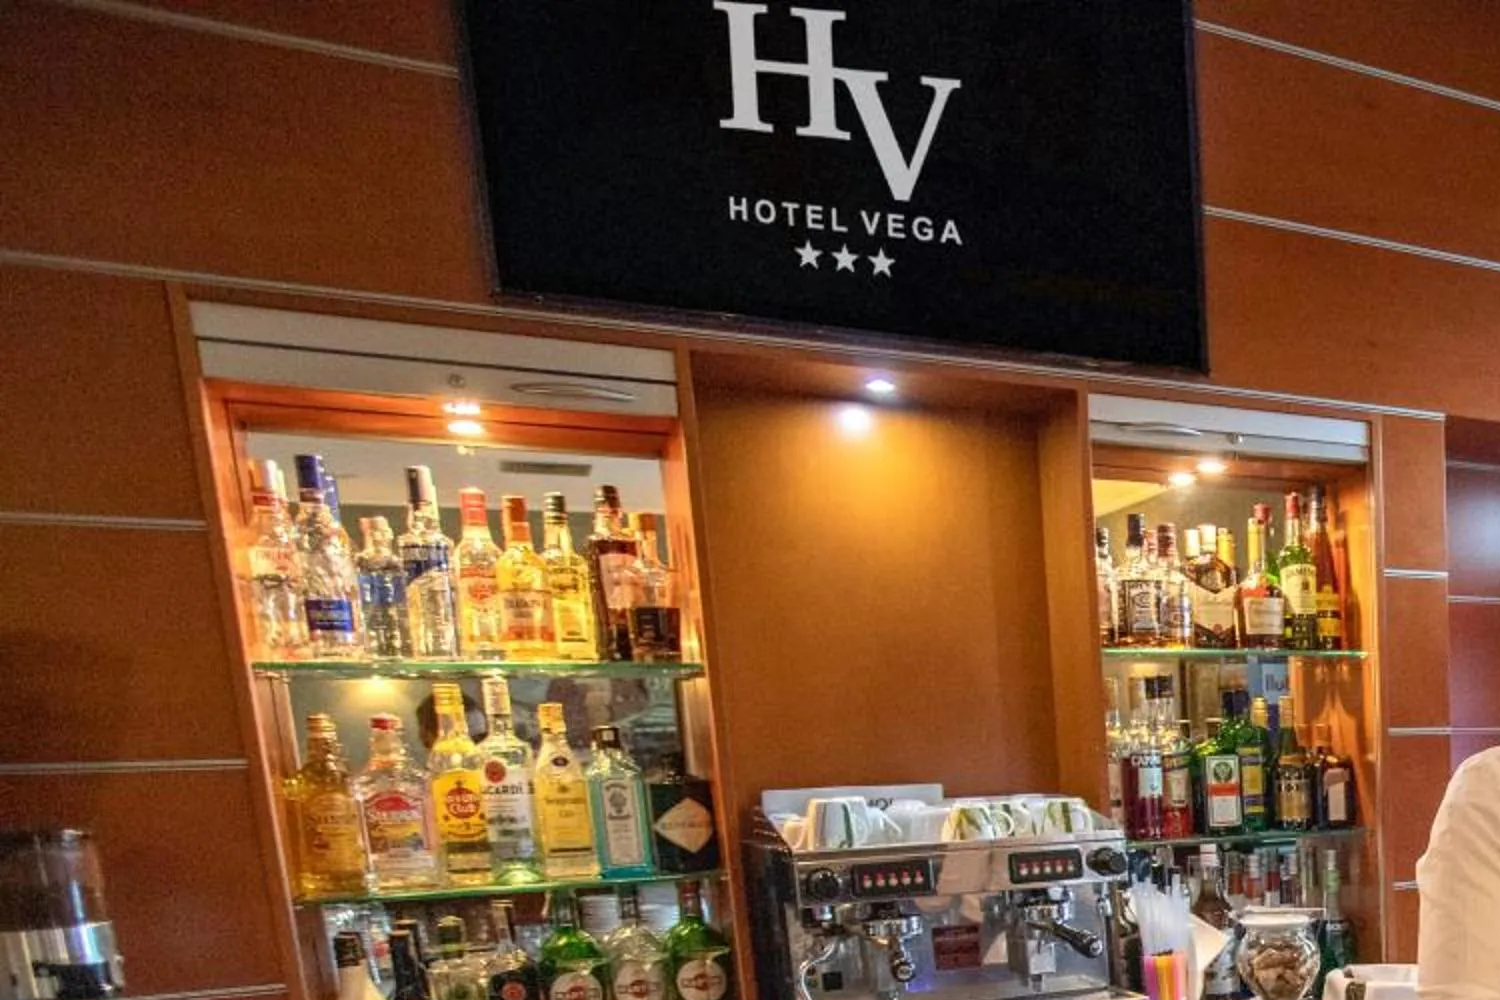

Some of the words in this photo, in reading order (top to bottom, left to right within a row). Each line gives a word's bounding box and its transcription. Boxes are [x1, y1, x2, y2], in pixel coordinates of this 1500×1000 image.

[714, 0, 960, 202] HV
[730, 197, 847, 231] HOTEL
[861, 211, 961, 245] VEGA
